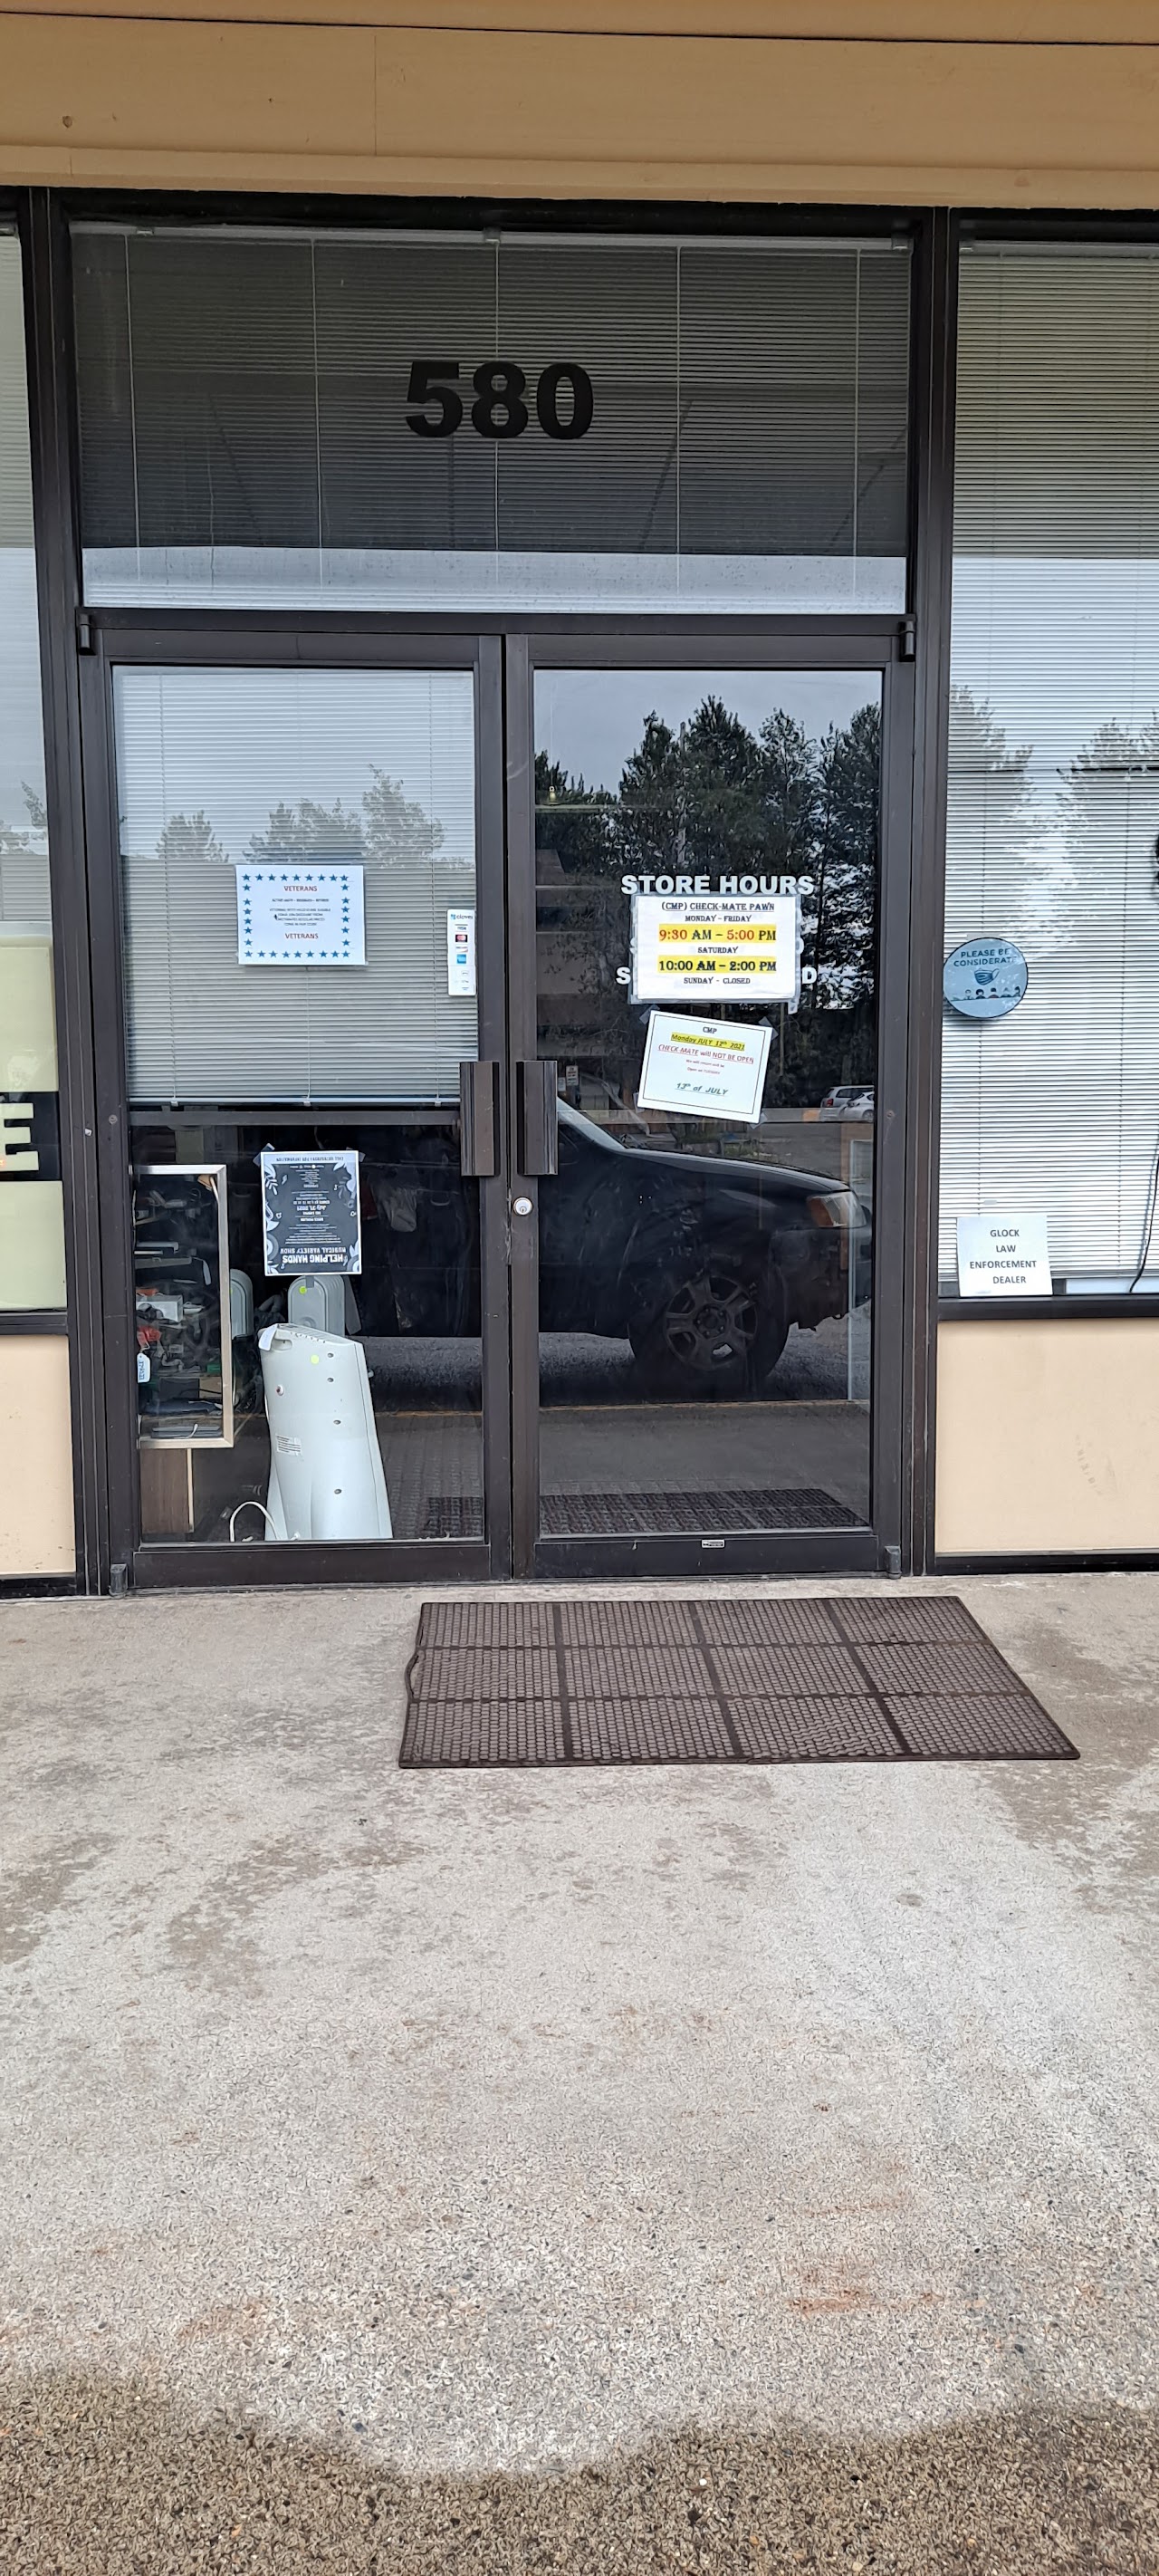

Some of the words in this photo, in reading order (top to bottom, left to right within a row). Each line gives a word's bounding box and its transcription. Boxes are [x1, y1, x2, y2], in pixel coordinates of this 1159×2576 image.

[405, 361, 594, 440] 580
[621, 875, 711, 895] STORE
[719, 875, 815, 895] HOURS
[661, 901, 687, 911] (CMP)
[689, 902, 747, 911] CHECK-MATE
[749, 902, 775, 911] PAWN
[659, 929, 687, 941] 9:30
[691, 929, 712, 940] AM
[726, 929, 754, 940] 5:00
[758, 930, 776, 941] PM
[961, 949, 995, 957] PLEASE
[659, 961, 694, 971] 10:00
[696, 961, 716, 971] AM
[729, 961, 755, 971] 2:00
[759, 962, 776, 971] PM
[703, 1026, 717, 1034] CMP
[671, 1033, 696, 1043] Monday
[697, 1038, 713, 1046] JULY
[730, 1043, 745, 1051] 2021
[658, 1044, 678, 1053] CHECK
[680, 1047, 698, 1055] MATE
[737, 1055, 754, 1064] OPEN
[705, 1087, 728, 1095] JULY
[990, 1229, 1020, 1237] GLOCK
[995, 1245, 1016, 1253] LAW
[283, 1254, 308, 1264] HANDS
[310, 1254, 343, 1263] HELPING
[969, 1260, 1037, 1269] ENFORCEMENT
[992, 1275, 1027, 1284] DEALER
